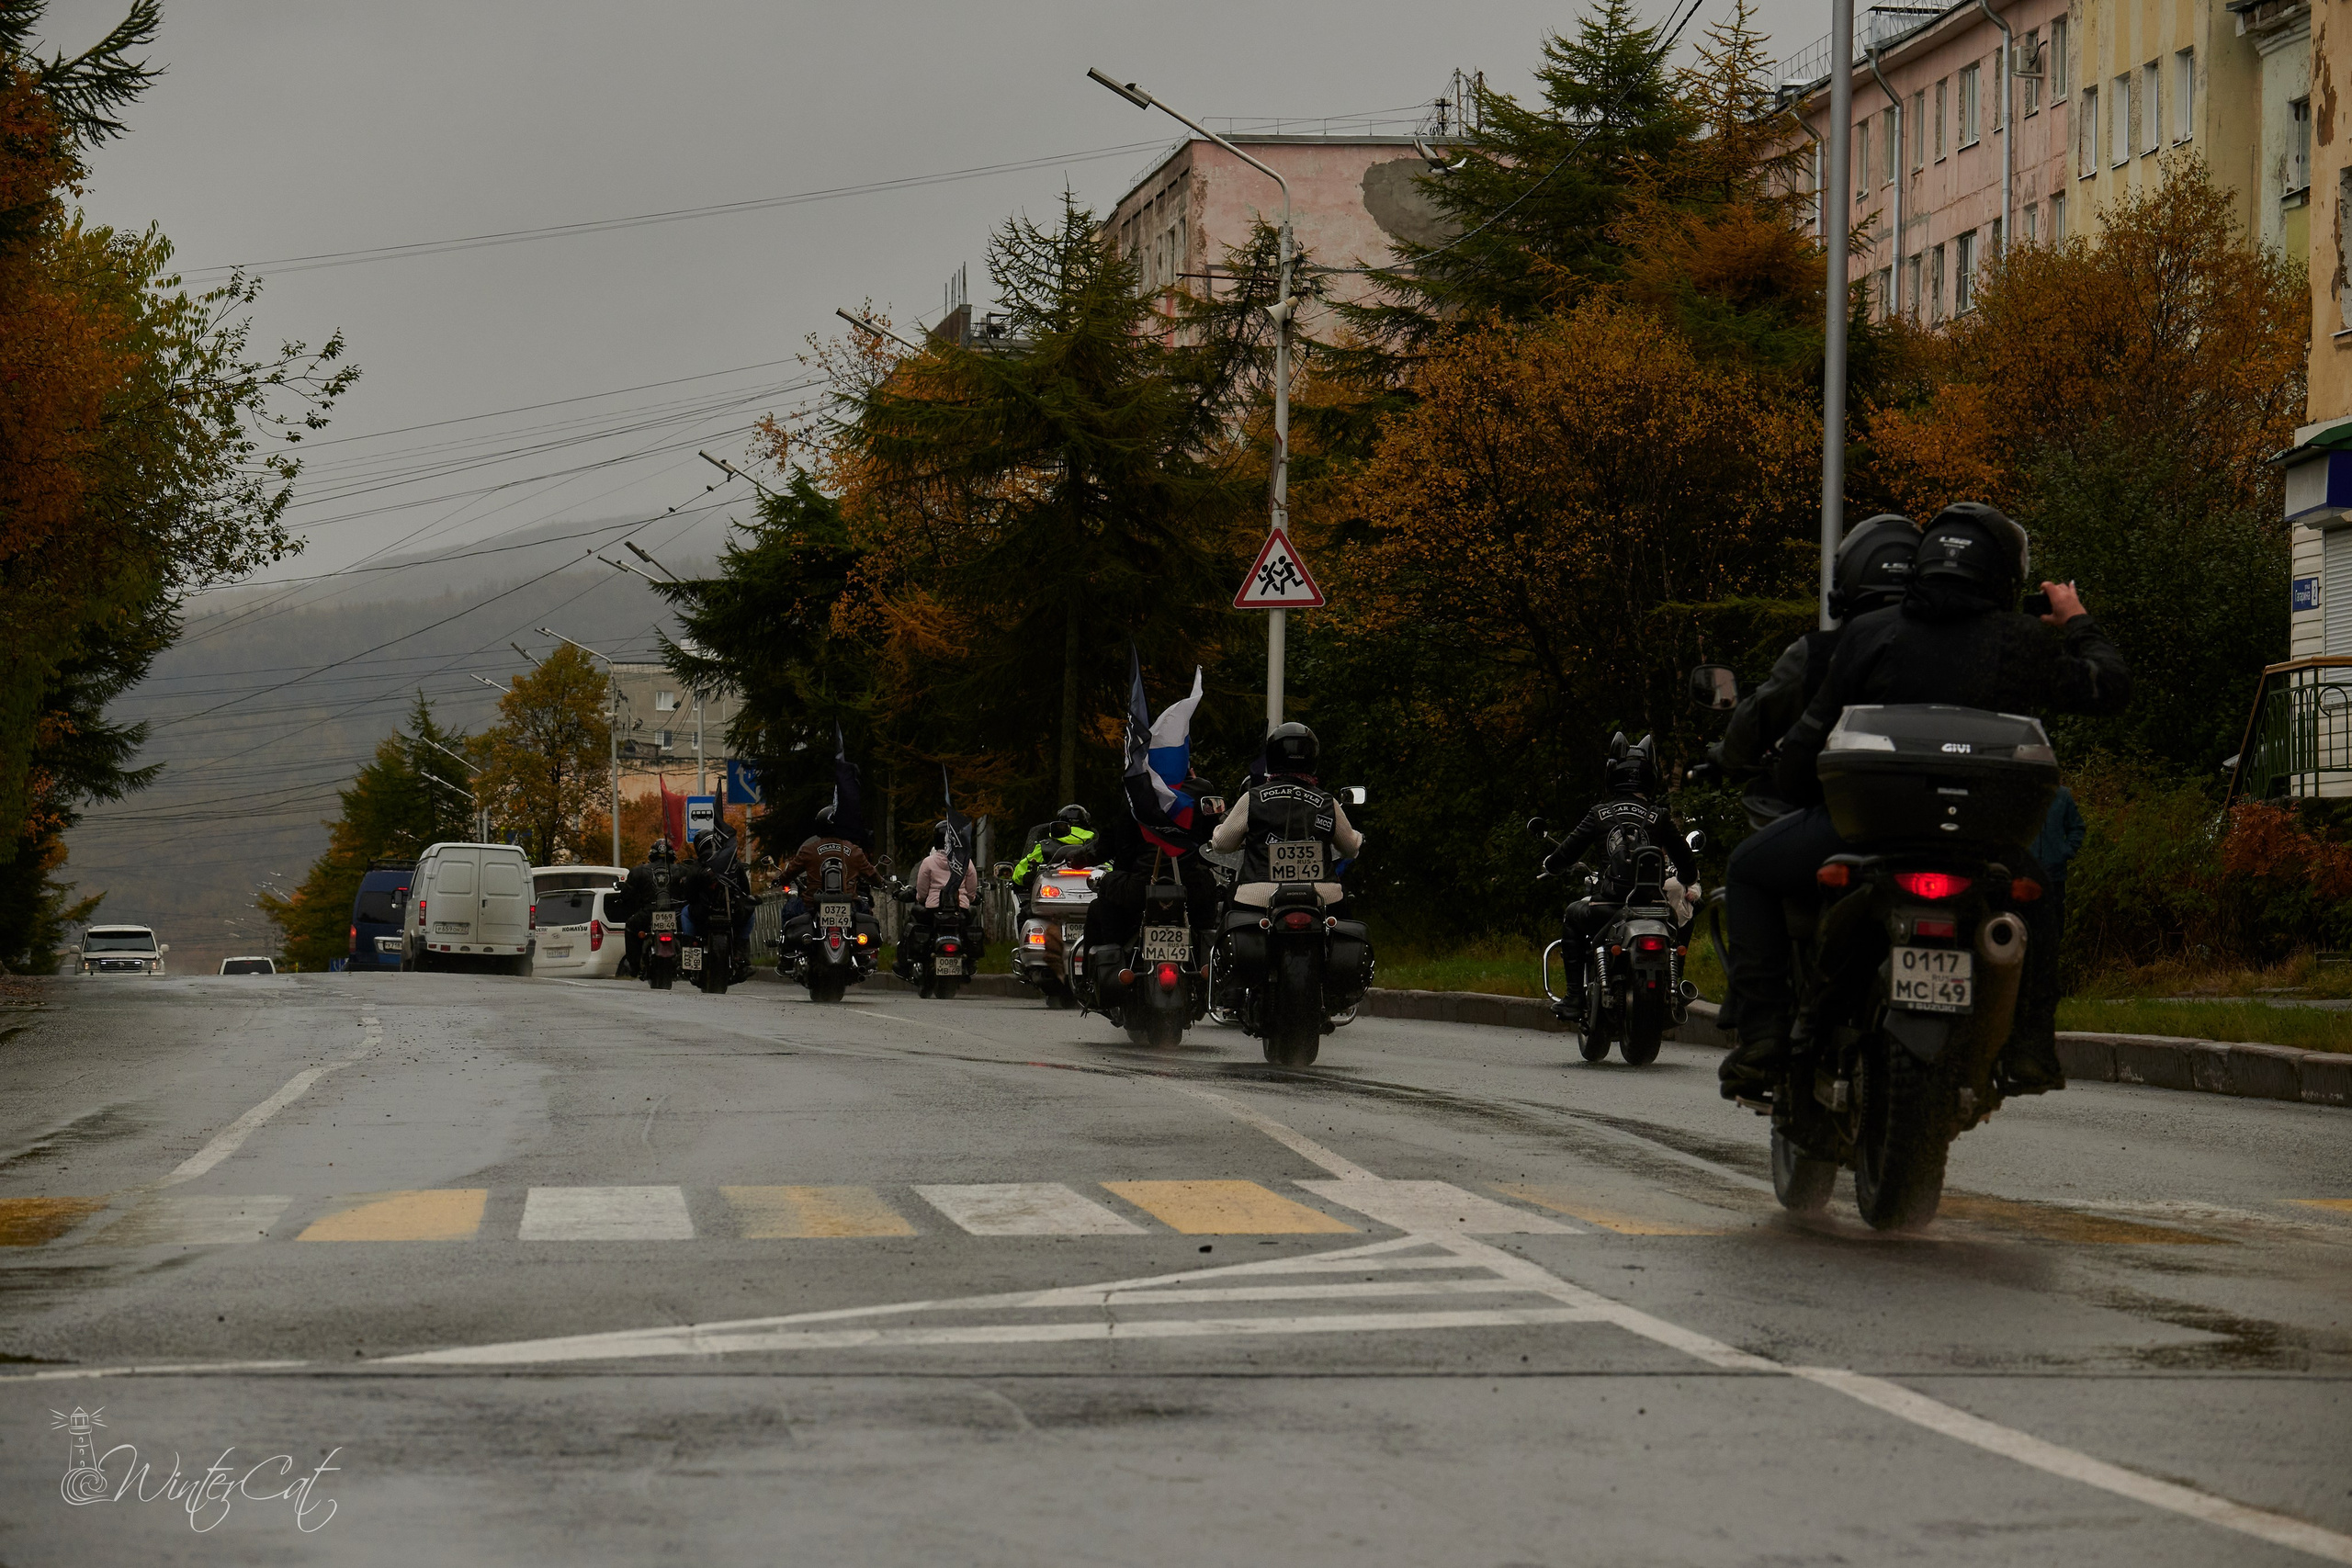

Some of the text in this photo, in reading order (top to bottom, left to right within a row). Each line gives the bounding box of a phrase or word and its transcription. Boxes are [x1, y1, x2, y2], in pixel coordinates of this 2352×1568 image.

[1262, 789, 1293, 799] POLAR
[1316, 818, 1331, 828] MCC
[1277, 846, 1315, 860] 0335
[1272, 864, 1320, 879] MB 49
[824, 906, 846, 915] 0372
[821, 917, 849, 926] MB 49
[1150, 930, 1182, 942] 0228
[693, 949, 701, 957] 49
[1146, 948, 1187, 959] MA 49
[1903, 951, 1959, 973] 0117
[1896, 979, 1965, 1002] MC 49
